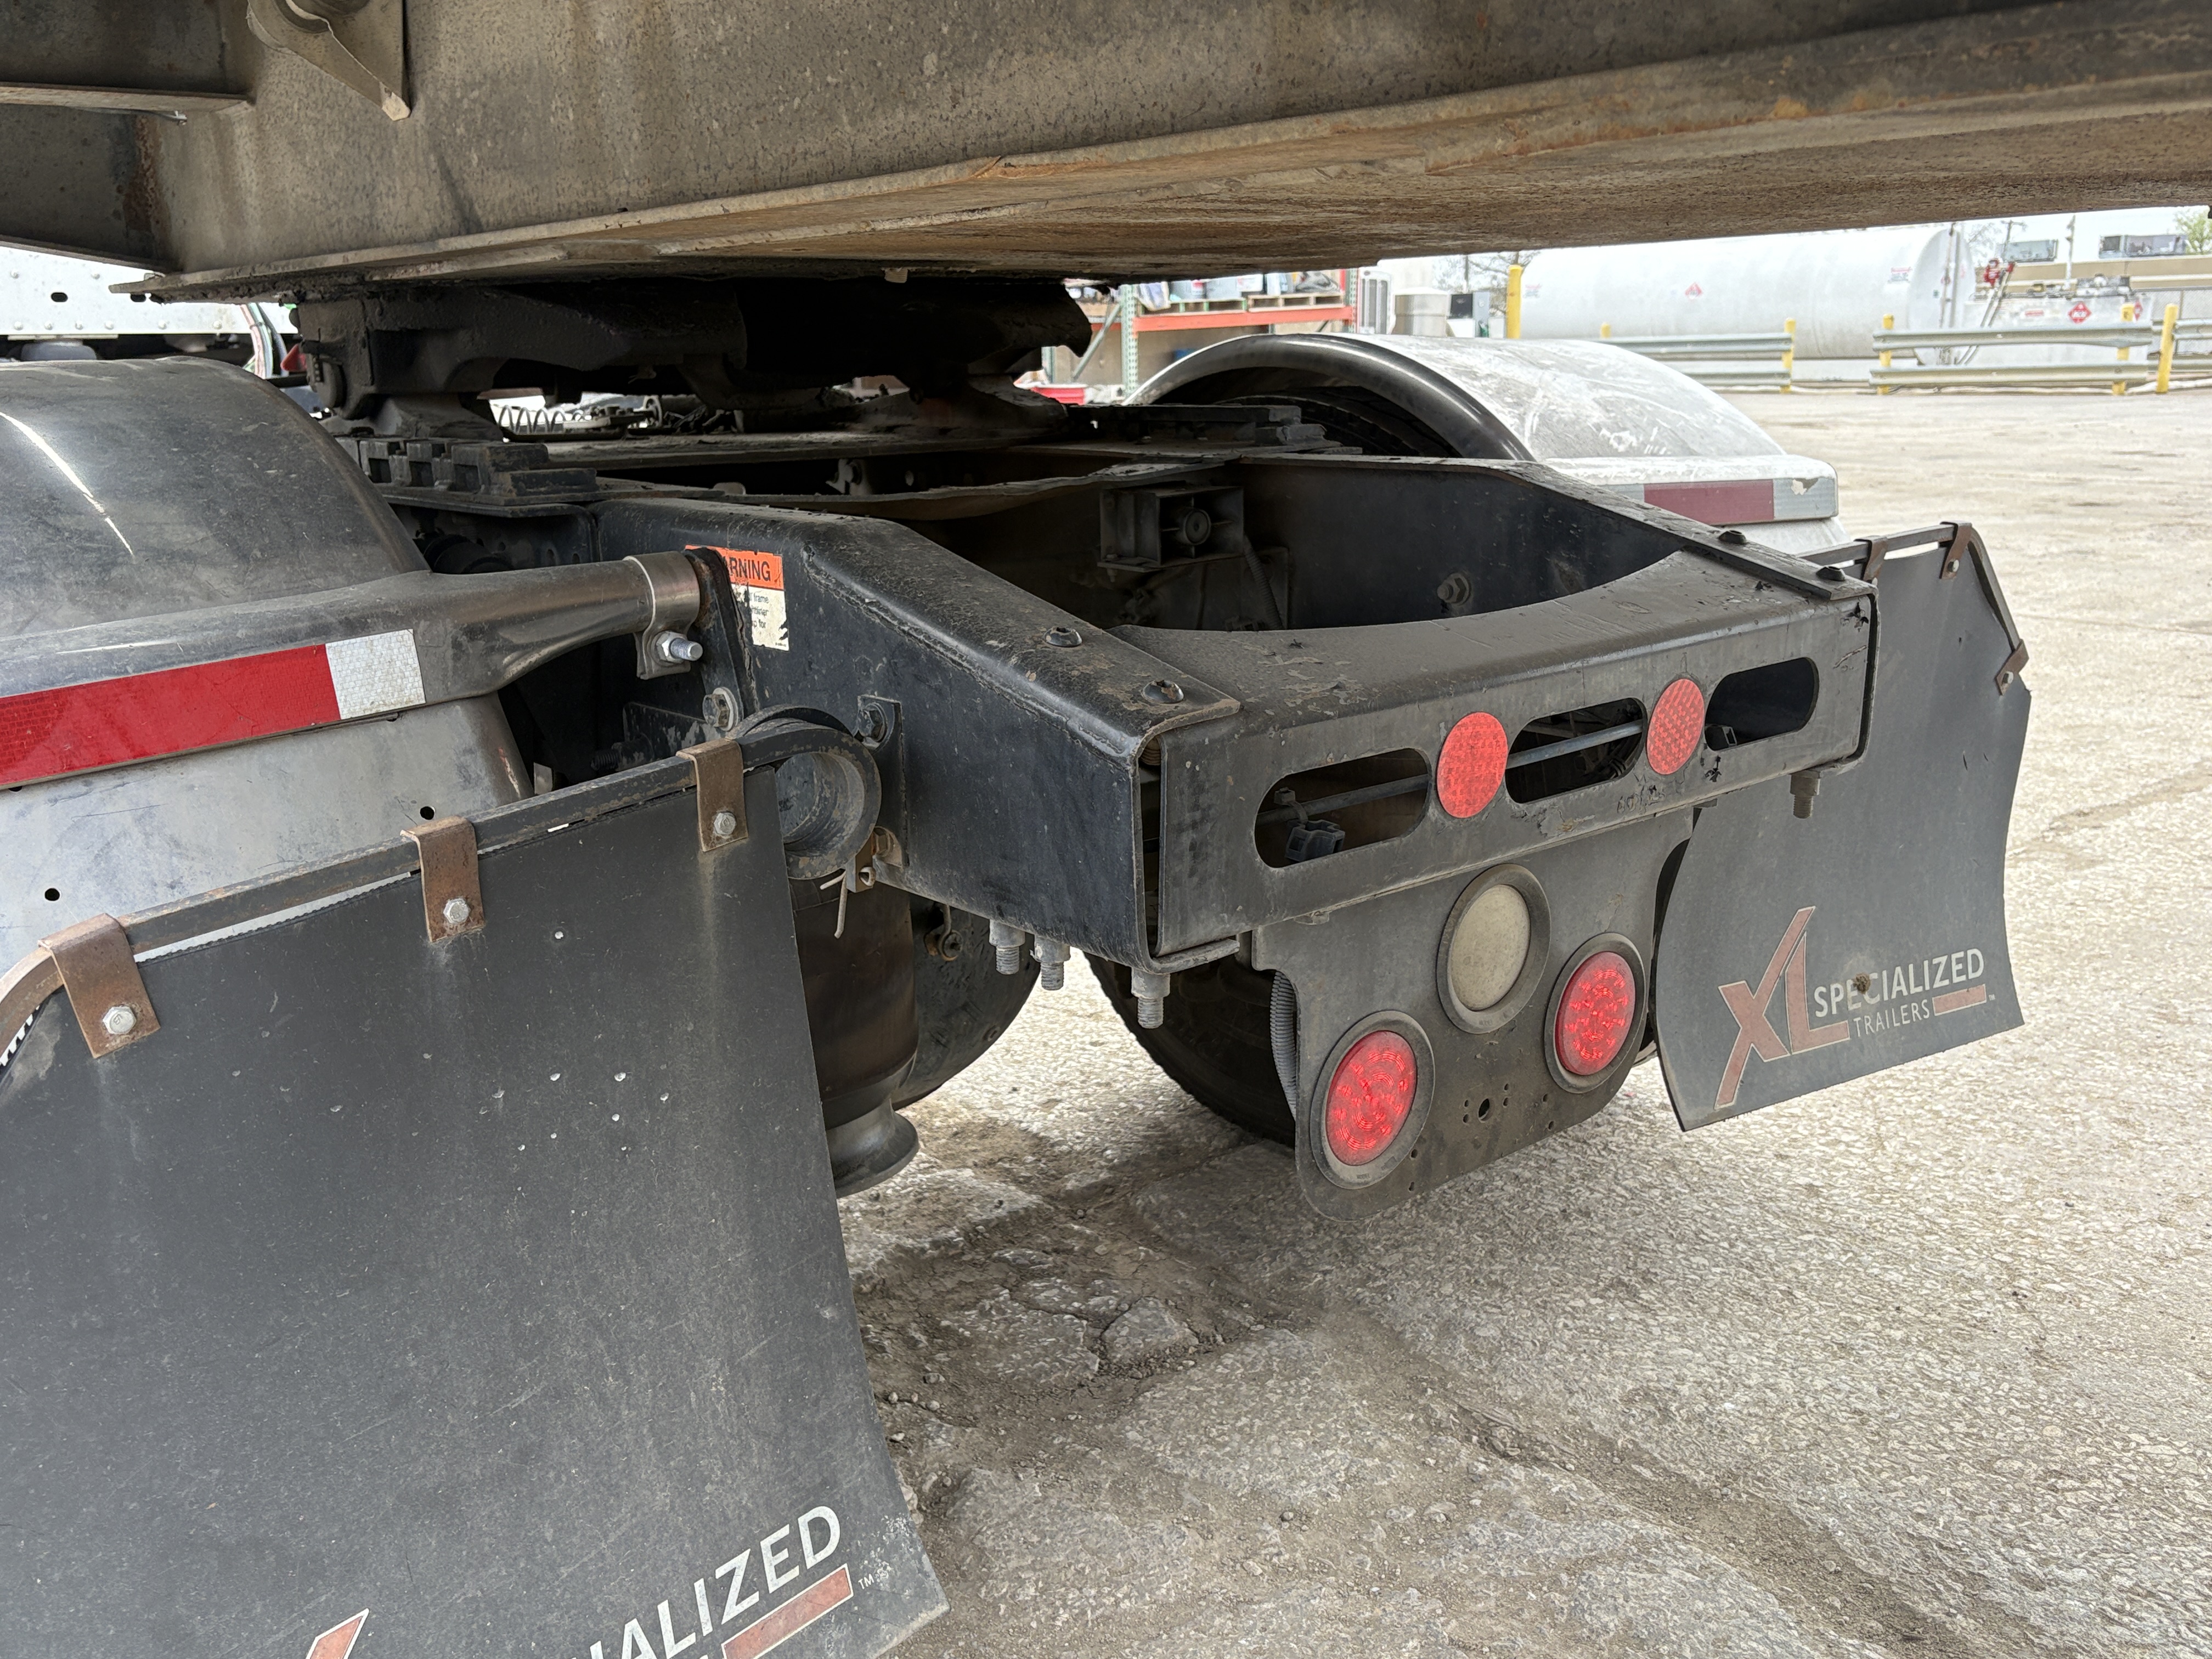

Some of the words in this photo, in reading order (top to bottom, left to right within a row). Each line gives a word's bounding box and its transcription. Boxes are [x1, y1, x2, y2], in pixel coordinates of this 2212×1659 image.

[724, 556, 771, 582] RNING
[1814, 948, 1984, 1018] SPECIALIZED
[1714, 906, 1850, 1109] XL
[1853, 999, 1930, 1037] TRAILERS
[857, 1573, 874, 1589] TM
